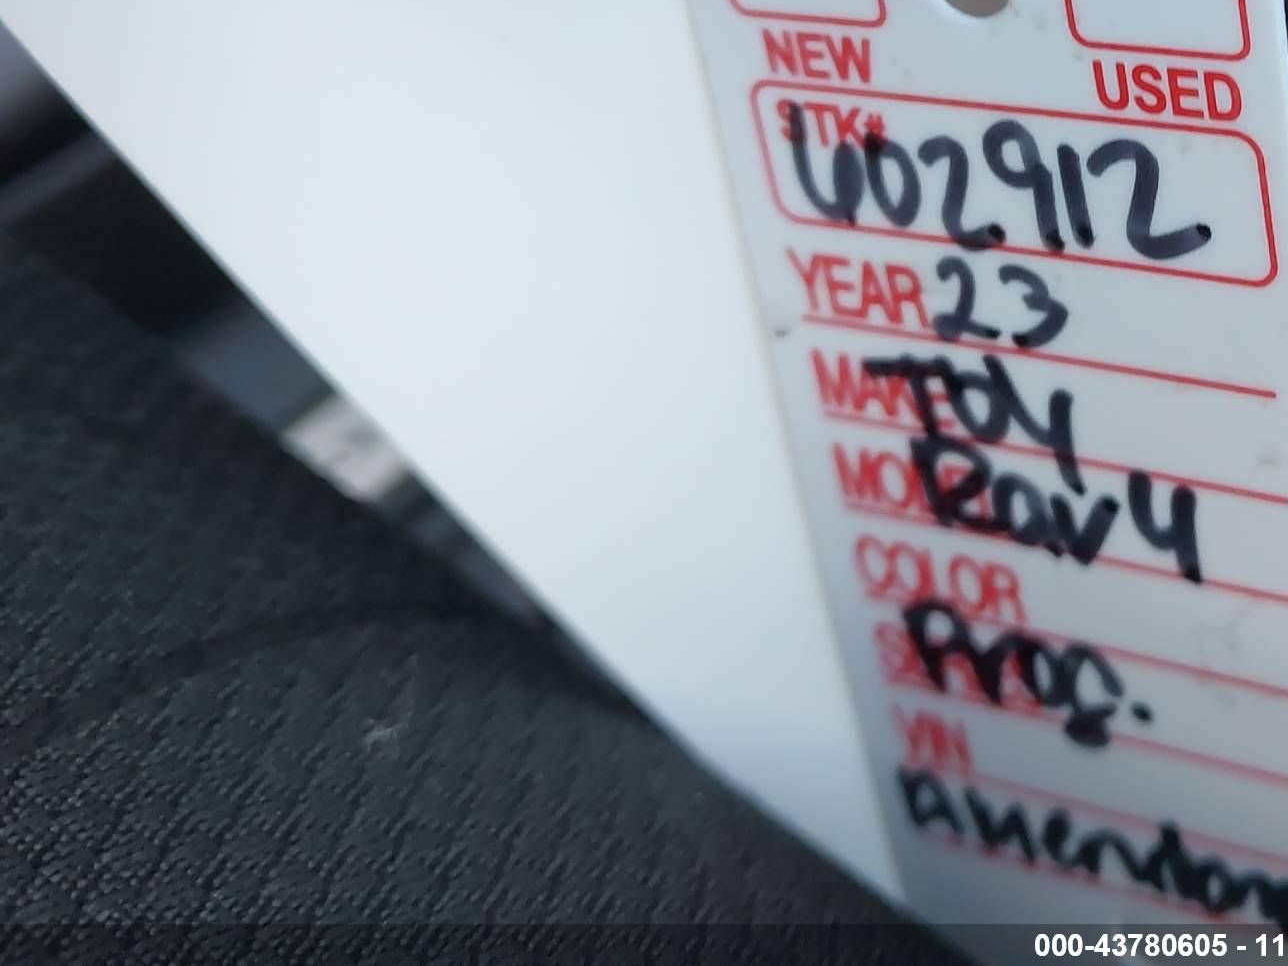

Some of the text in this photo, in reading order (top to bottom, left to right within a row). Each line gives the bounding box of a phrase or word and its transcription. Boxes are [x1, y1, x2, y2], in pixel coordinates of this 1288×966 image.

[762, 29, 872, 84] NEW
[1092, 60, 1243, 122] USED
[776, 99, 886, 149] STK#
[788, 101, 1212, 261] 602912
[787, 247, 931, 331] YEAR
[932, 255, 1069, 348] 23
[854, 533, 1029, 626] COLOR
